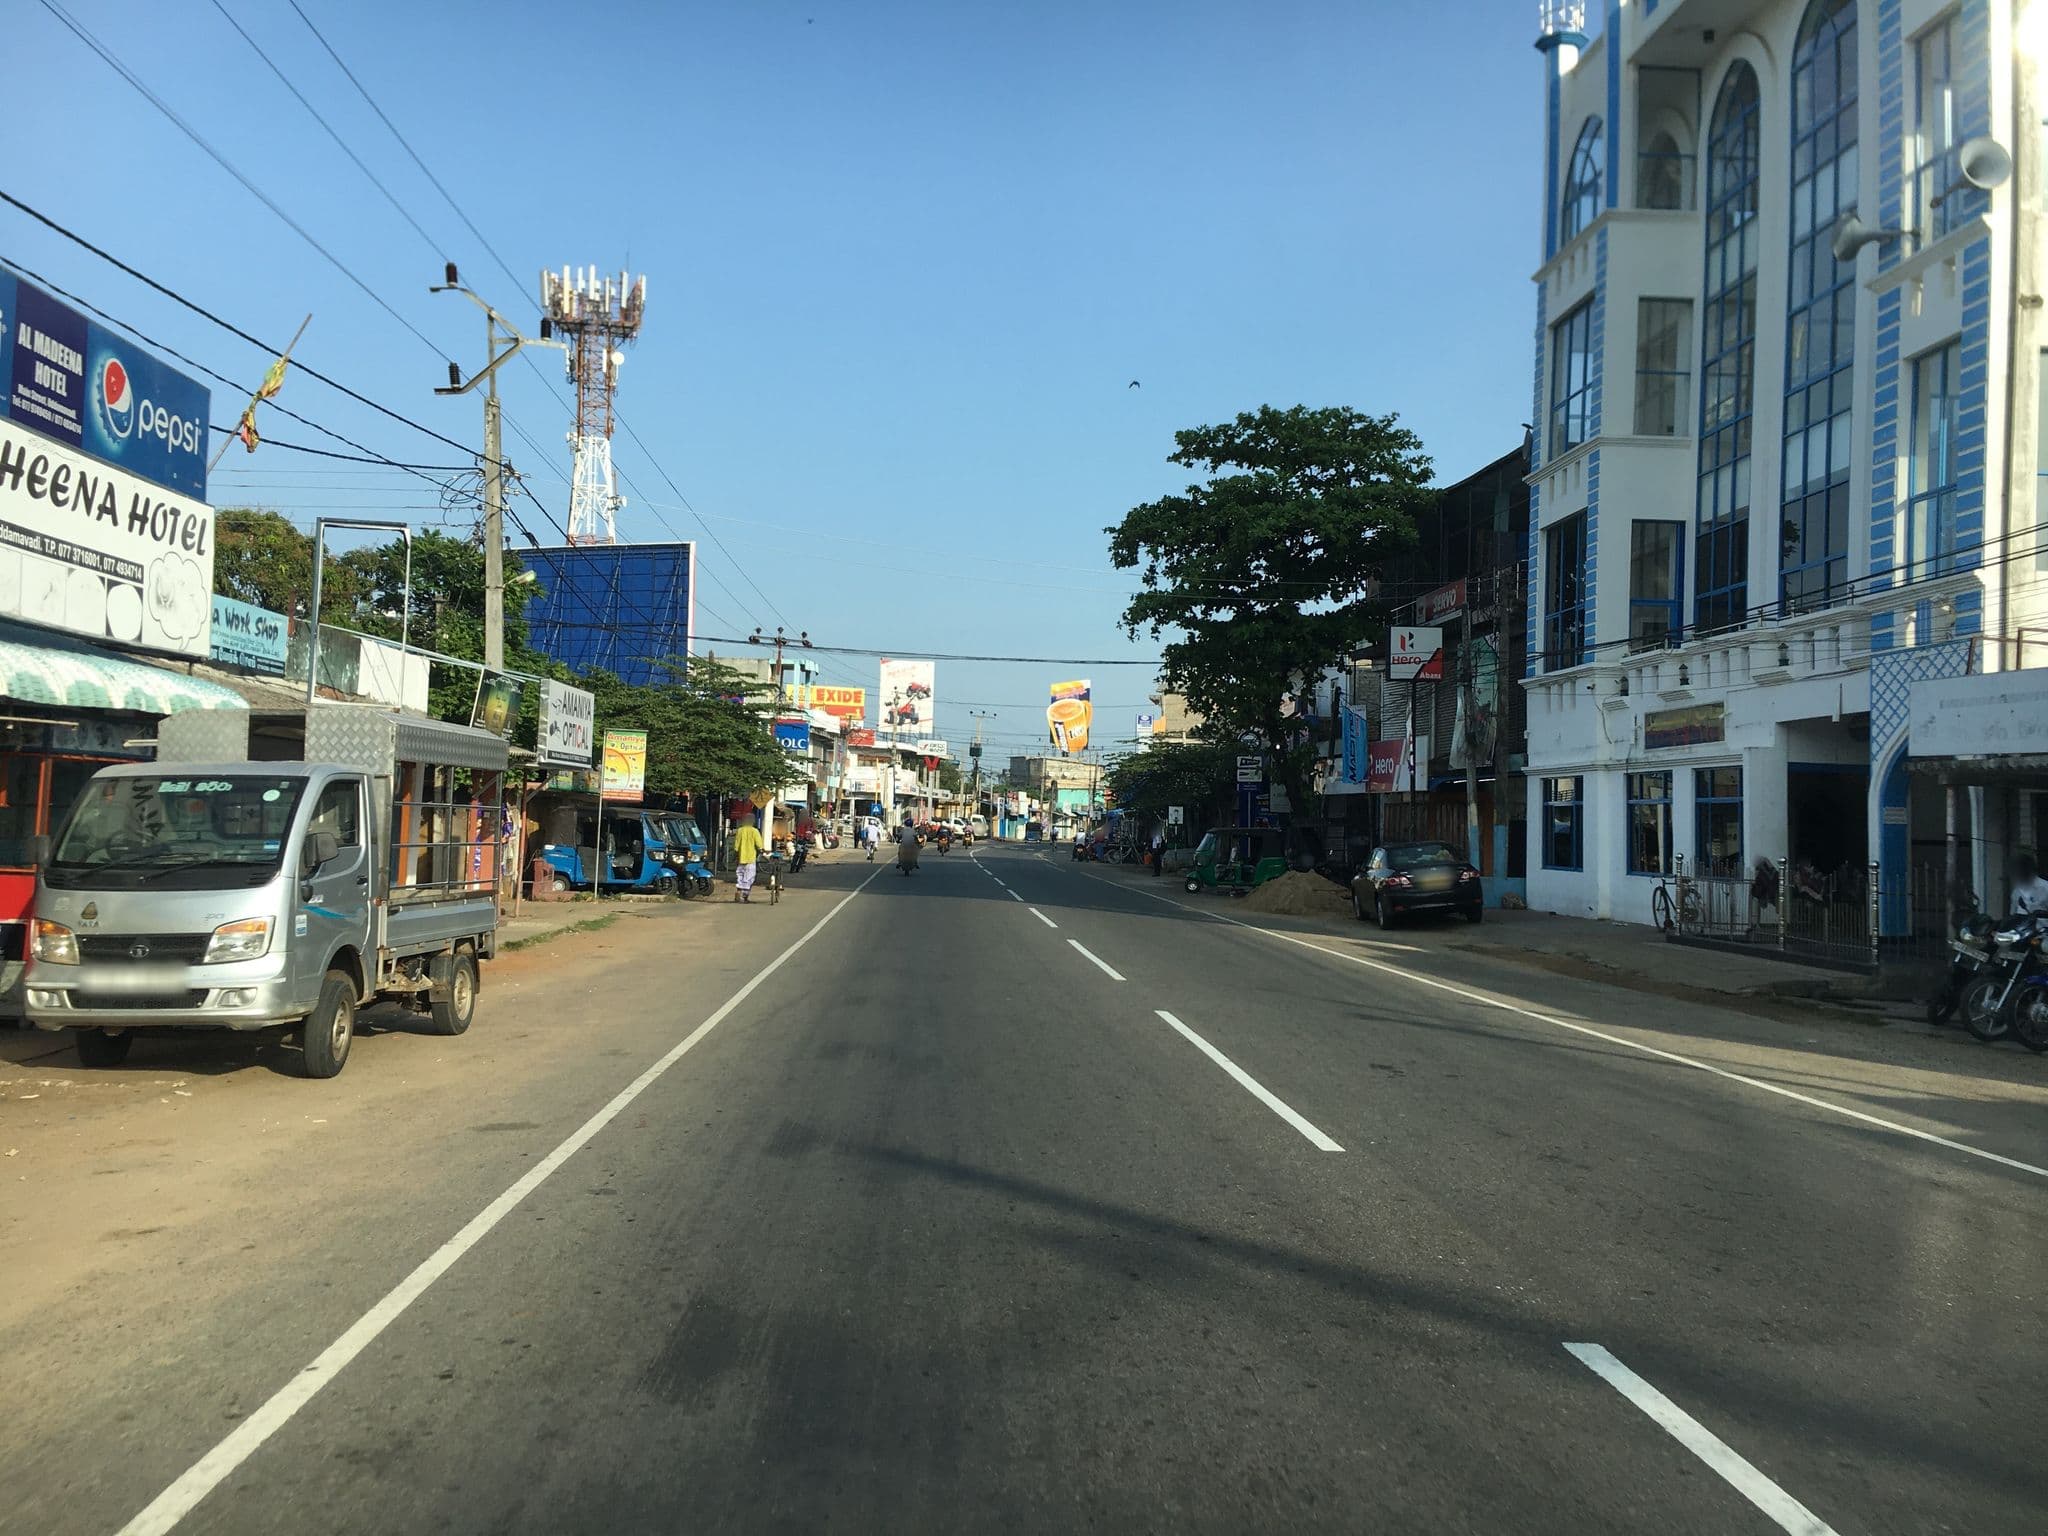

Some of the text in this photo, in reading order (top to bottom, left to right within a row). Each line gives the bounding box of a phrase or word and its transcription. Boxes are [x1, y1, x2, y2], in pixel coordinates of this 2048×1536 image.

[18, 322, 83, 376] AL MADEENA
[34, 360, 68, 397] HOTEL
[138, 399, 201, 455] pepsi
[128, 492, 207, 556] HOTEL
[44, 538, 57, 555] T.P.
[58, 543, 72, 560] 077
[103, 558, 116, 572] 077
[1392, 655, 1422, 665] Hero
[1419, 671, 1441, 679] Abans
[562, 690, 592, 721] AMANIYA
[816, 688, 862, 703] EXIDE
[562, 721, 589, 750] OPTICAL
[607, 732, 646, 743] Amaniya
[777, 737, 807, 749] OLC
[1375, 757, 1394, 775] Hero
